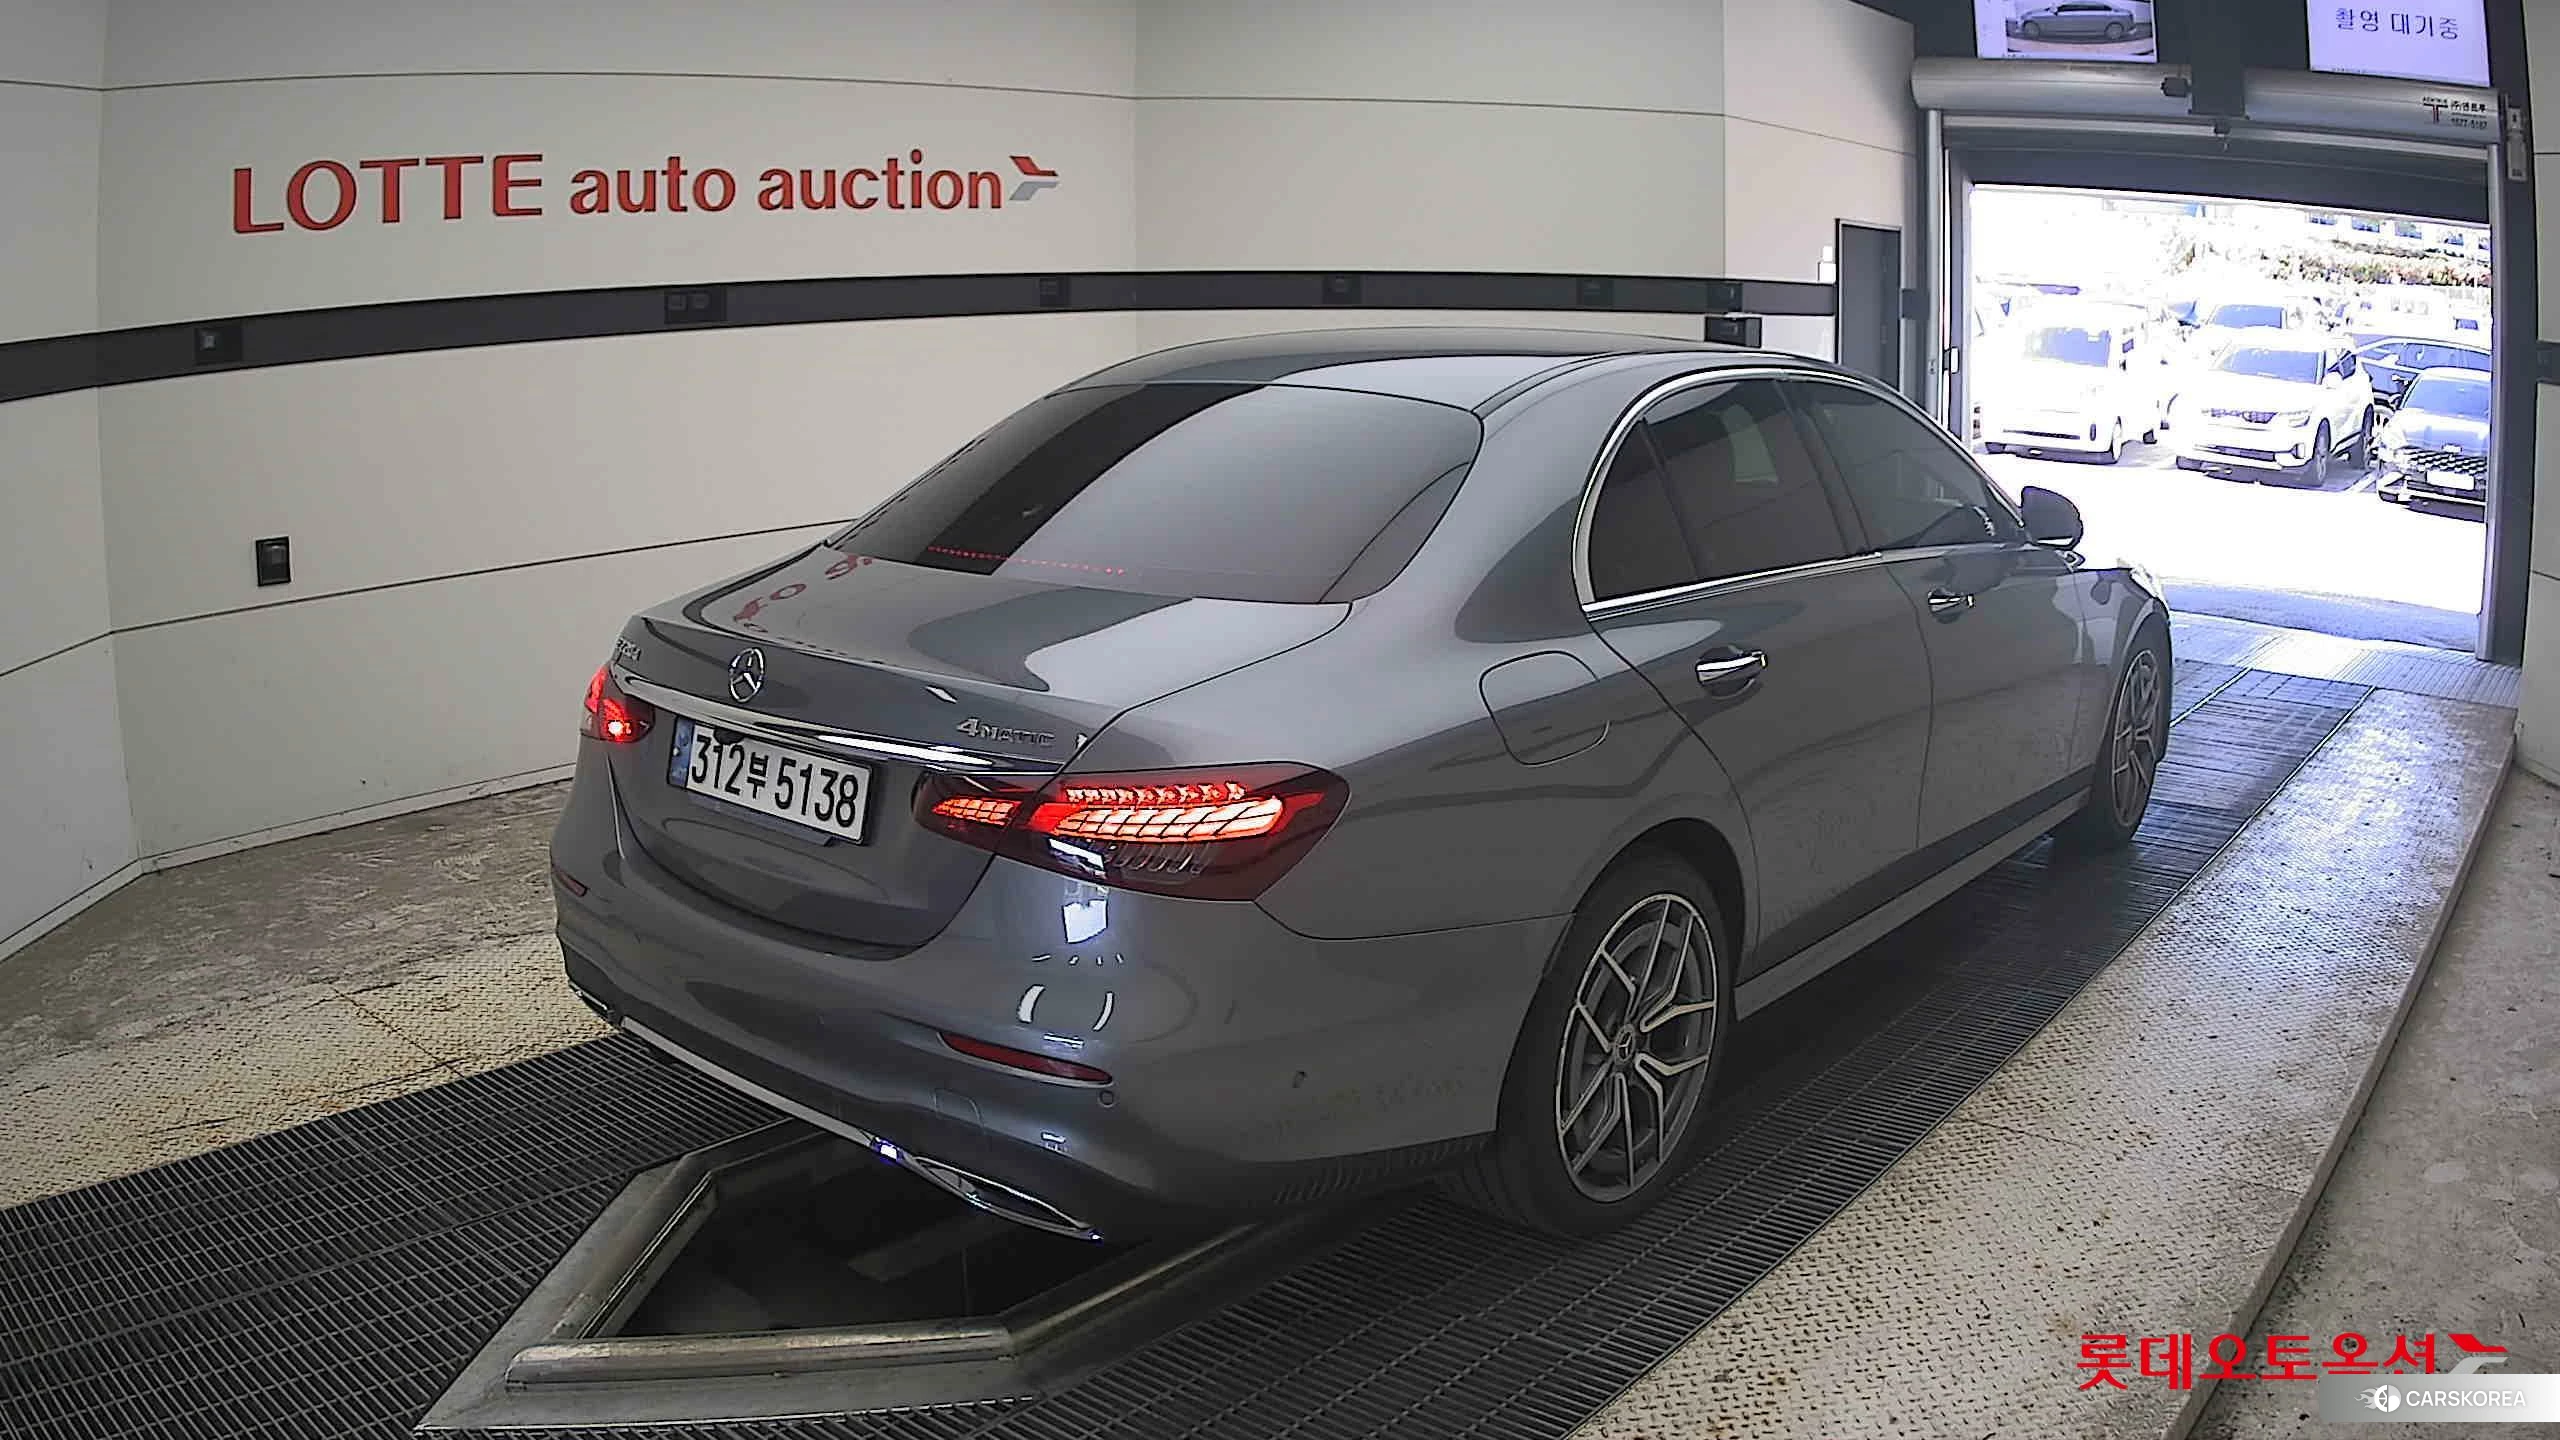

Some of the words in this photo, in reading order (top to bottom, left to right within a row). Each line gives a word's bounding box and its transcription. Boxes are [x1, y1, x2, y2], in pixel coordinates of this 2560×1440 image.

[2391, 13, 2458, 40] 대기중
[233, 153, 543, 235] LOTTE
[569, 155, 737, 215] auto
[757, 148, 1003, 212] auction
[691, 734, 769, 800] 312부
[774, 756, 860, 828] 5138
